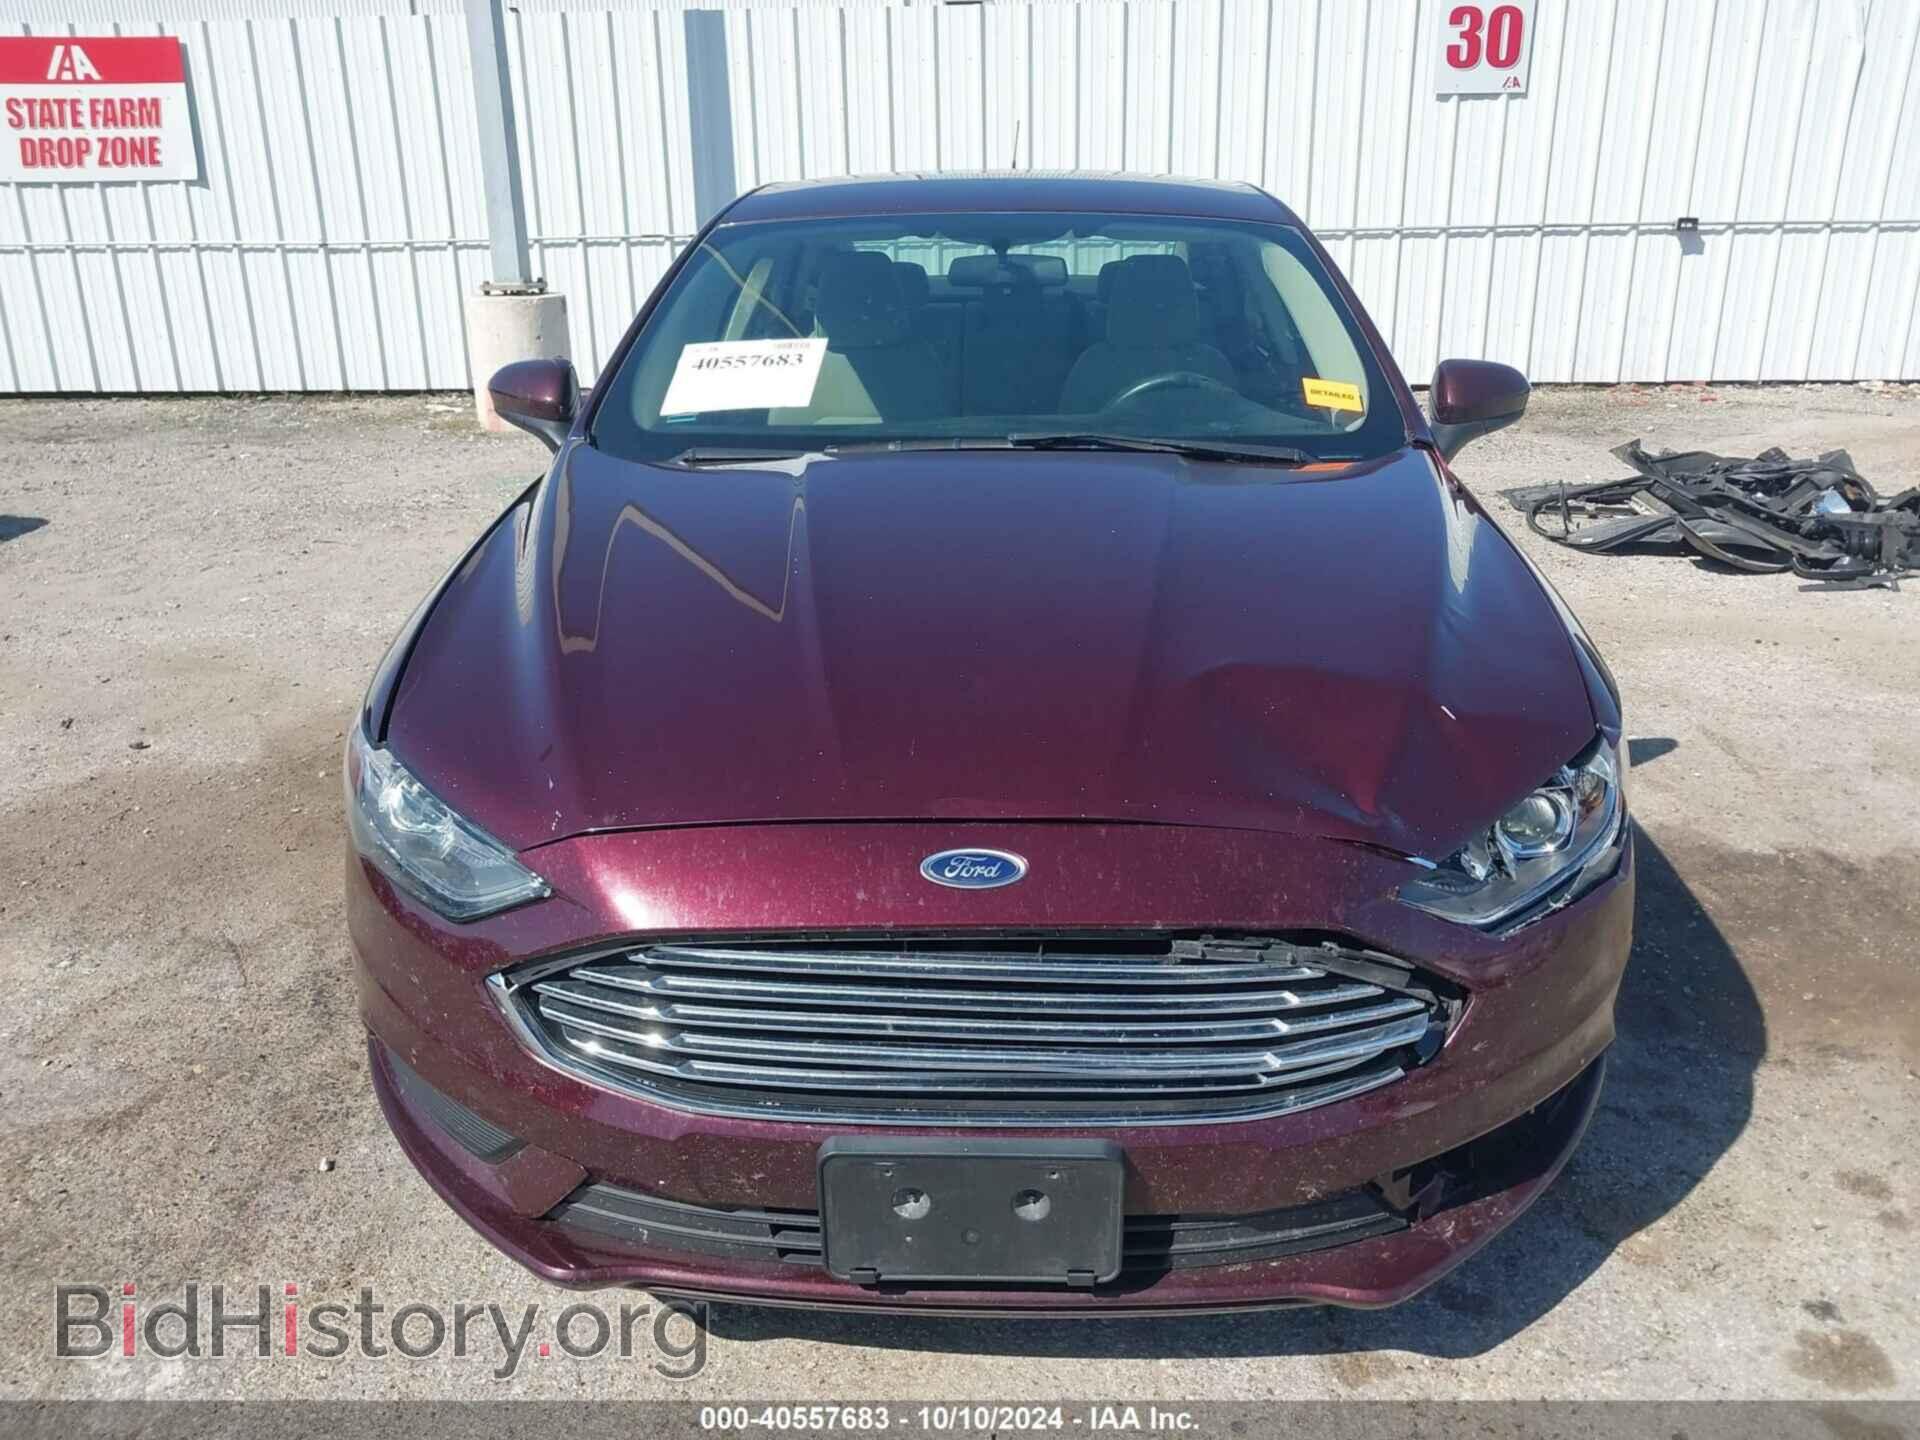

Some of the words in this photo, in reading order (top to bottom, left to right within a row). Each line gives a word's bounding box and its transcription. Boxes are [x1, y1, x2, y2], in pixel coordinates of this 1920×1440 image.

[1446, 5, 1524, 69] 30
[6, 98, 85, 129] STATE
[89, 97, 163, 129] FARM
[19, 137, 91, 169] DROP
[96, 136, 163, 168] ZONE
[691, 352, 805, 371] 40557683
[1310, 388, 1355, 401] DETAILED
[943, 855, 1002, 878] Ford
